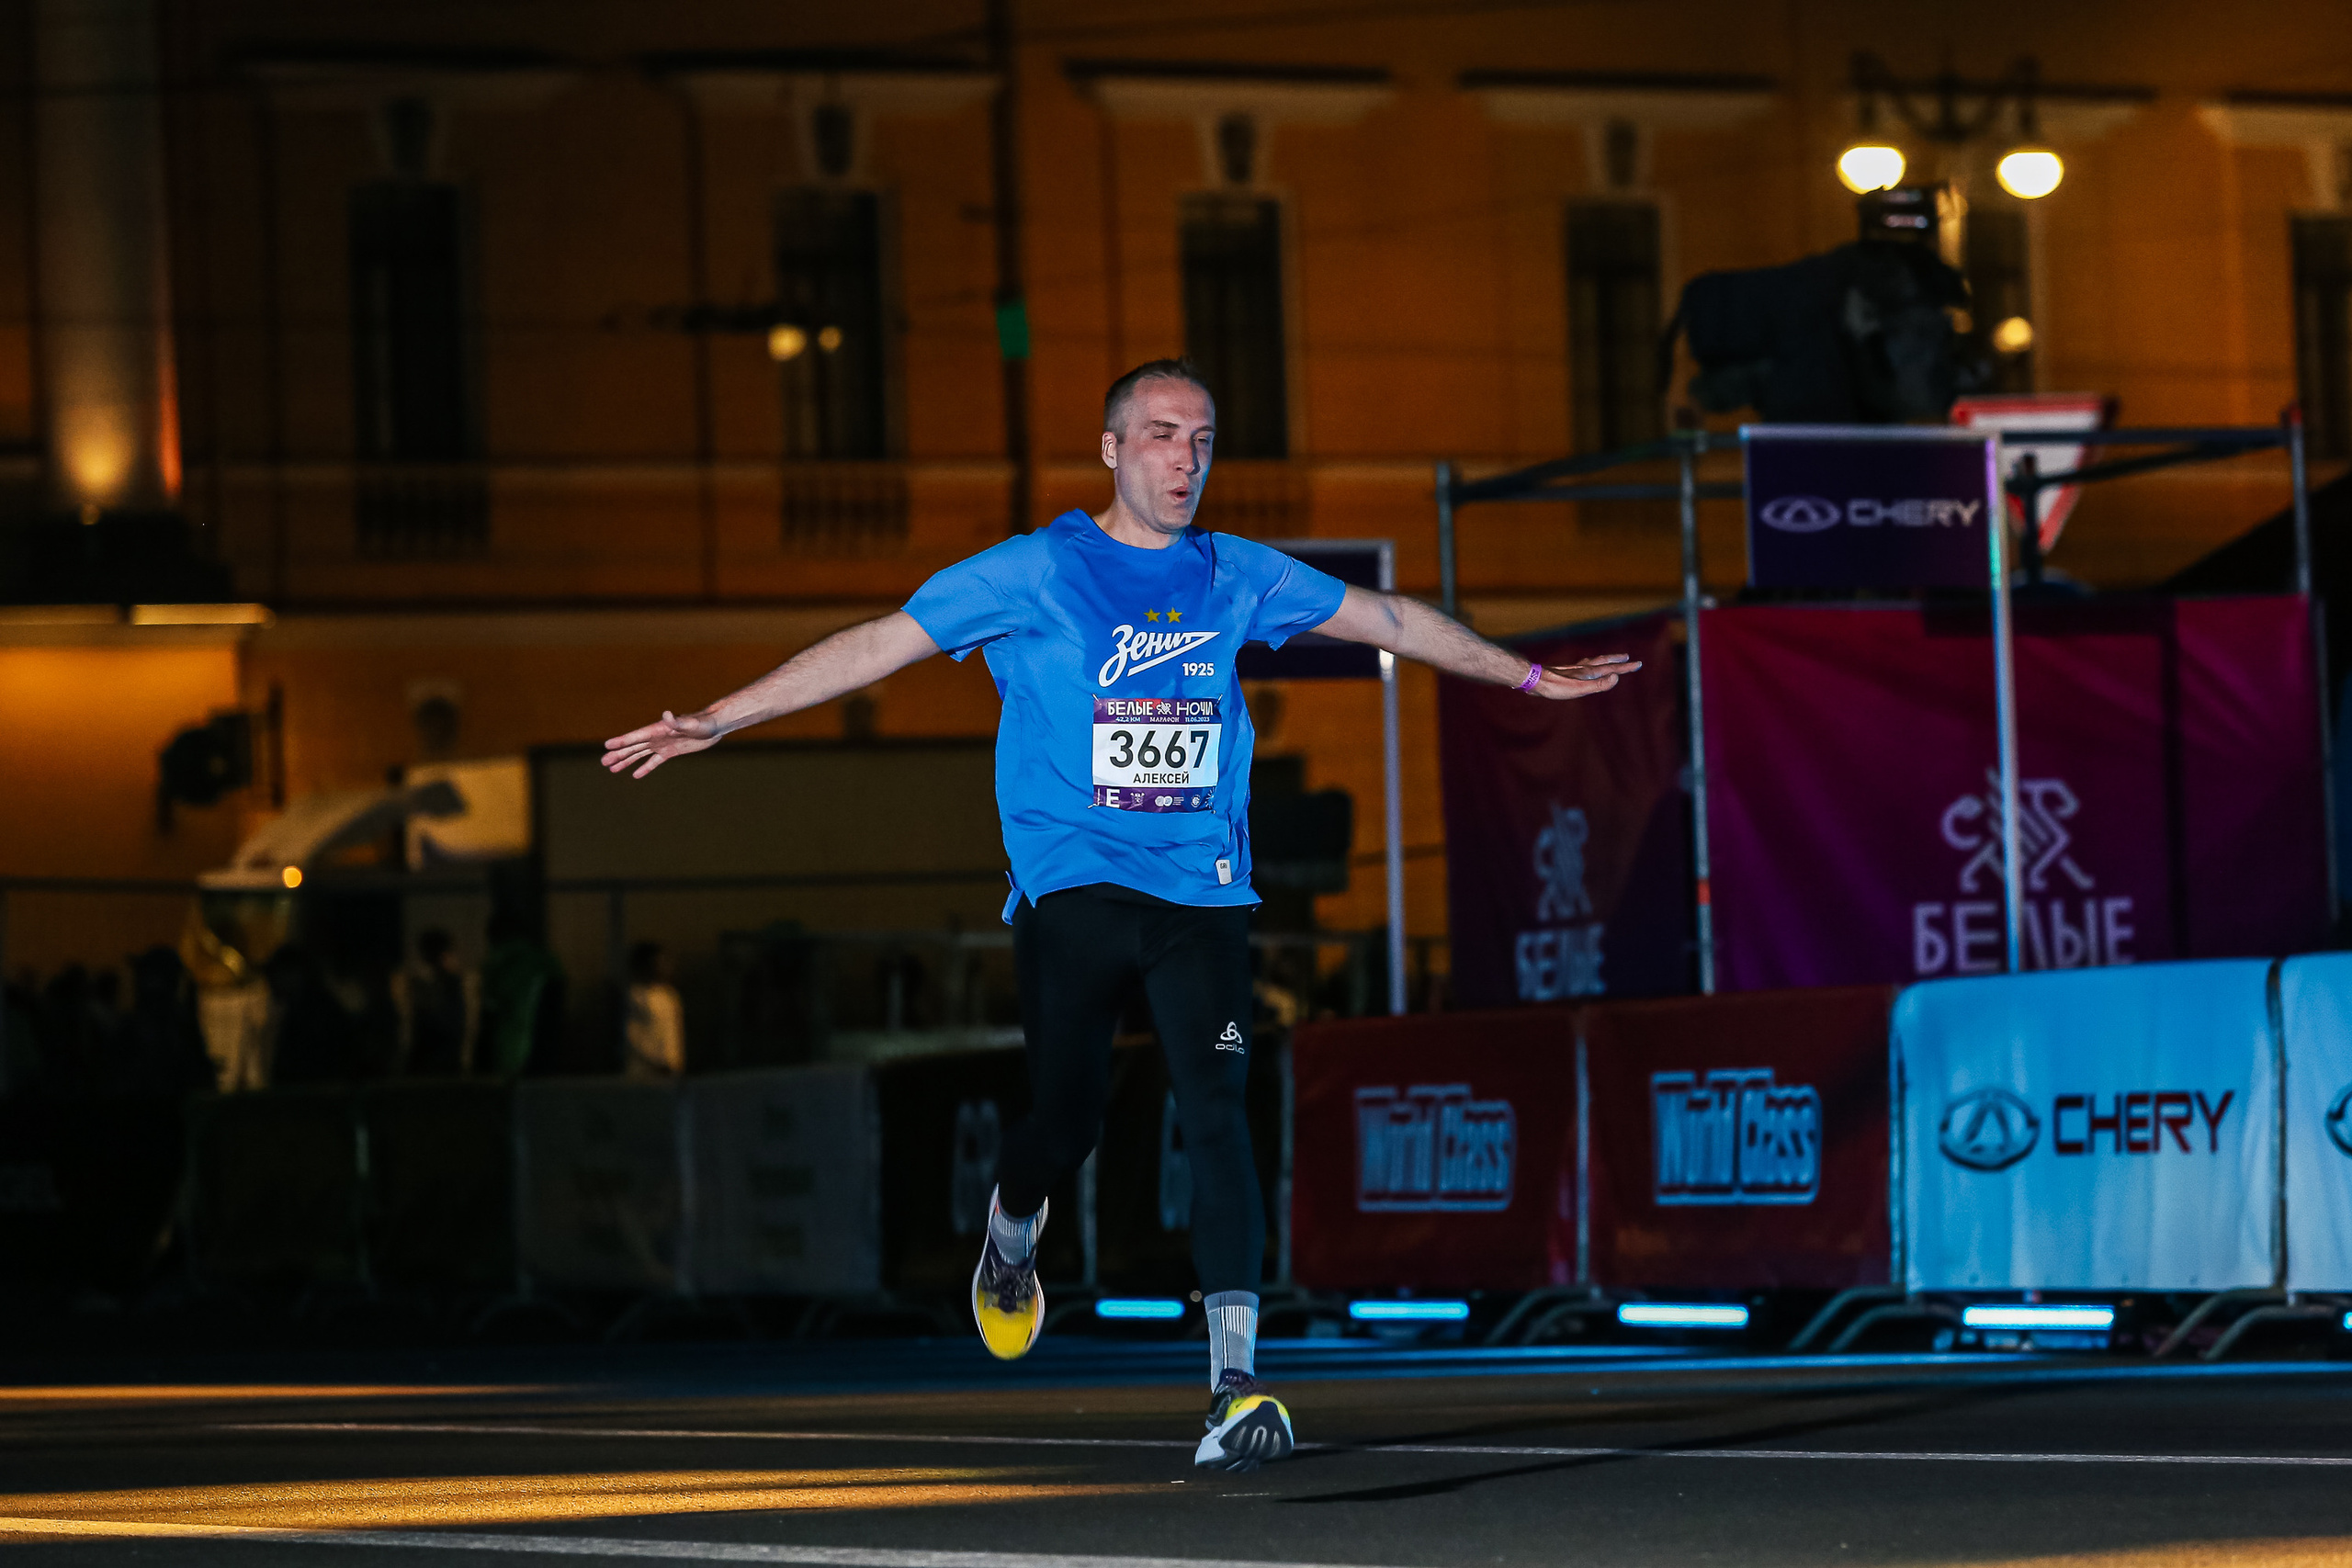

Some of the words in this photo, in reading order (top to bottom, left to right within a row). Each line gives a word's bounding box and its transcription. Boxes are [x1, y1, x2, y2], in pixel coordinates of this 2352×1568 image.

[1847, 498, 1980, 527] CHERY
[1098, 624, 1221, 688] Зенит
[1182, 662, 1215, 676] 1925
[1107, 701, 1153, 716] БЕЛЫЕ
[1176, 701, 1214, 716] НОЧИ
[1109, 730, 1209, 768] 3667
[1133, 771, 1190, 784] АЛЕКСЕЙ
[2052, 1090, 2234, 1155] CHERY
